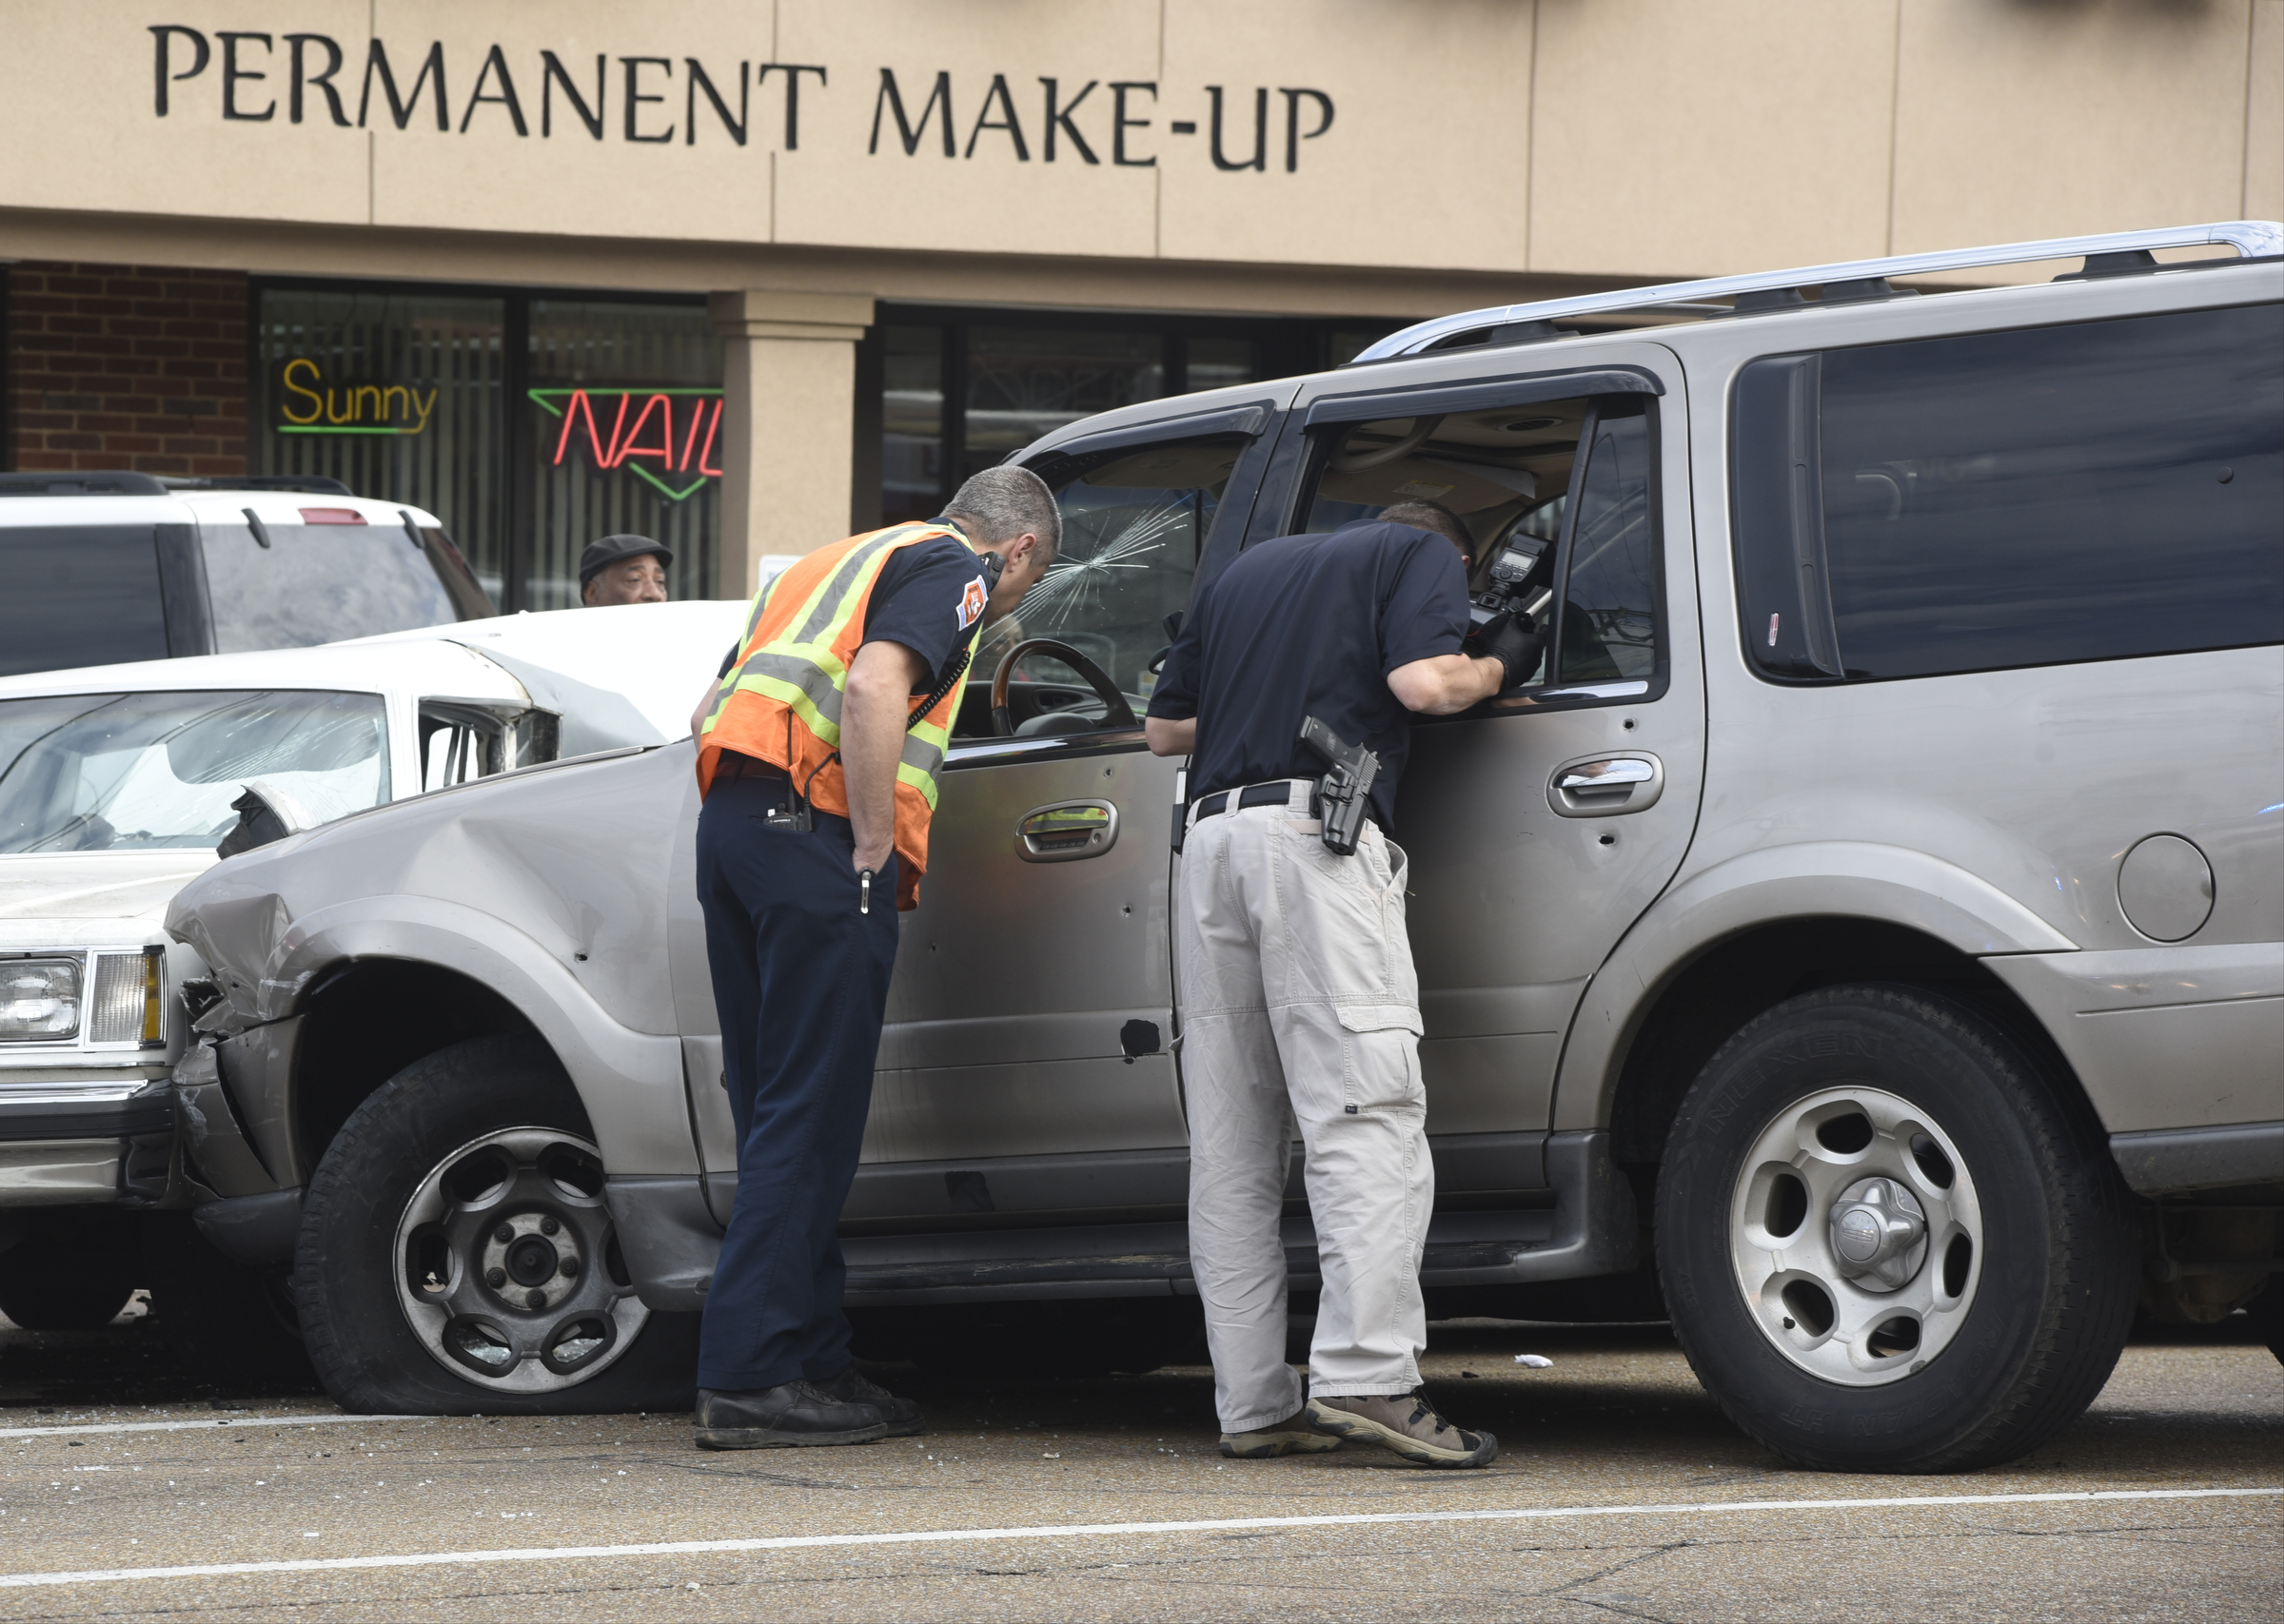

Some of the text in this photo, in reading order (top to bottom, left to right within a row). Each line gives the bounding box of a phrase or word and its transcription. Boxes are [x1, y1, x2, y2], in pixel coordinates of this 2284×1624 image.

[148, 25, 1335, 174] PERMANENT MAKE-UP
[282, 358, 437, 434] Sunny
[1704, 1035, 1881, 1135] NEXEN
[1851, 1309, 2007, 1437] ROADIAN
